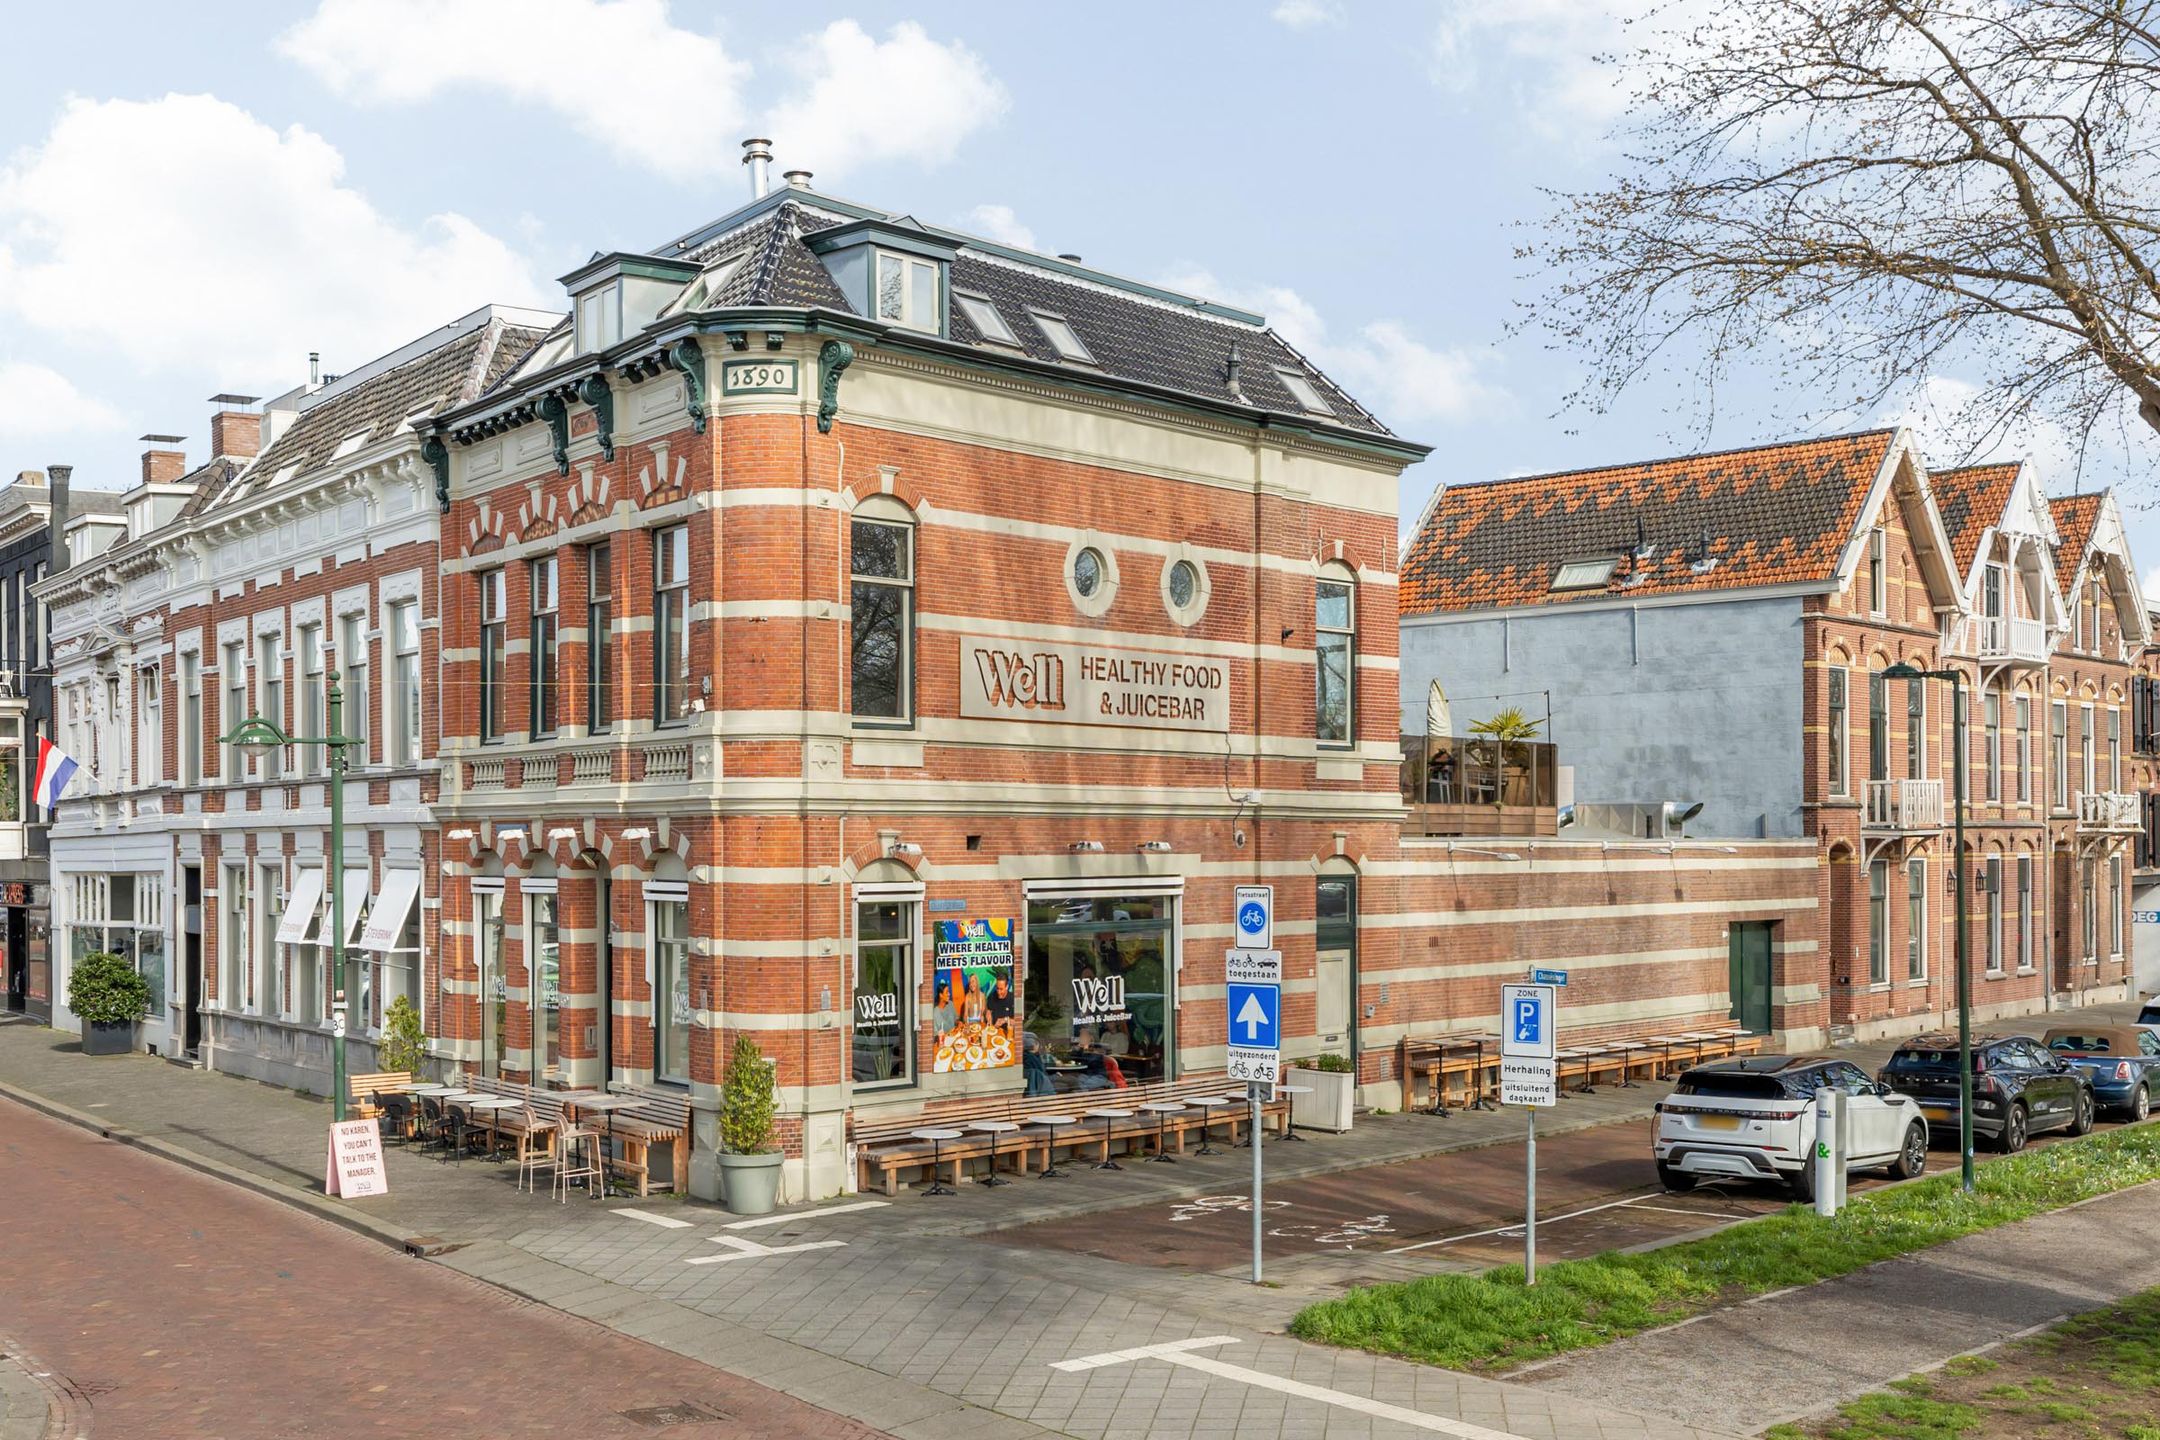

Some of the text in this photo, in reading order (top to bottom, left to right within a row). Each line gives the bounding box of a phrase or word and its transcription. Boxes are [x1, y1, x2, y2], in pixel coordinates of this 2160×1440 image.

[733, 366, 785, 386] 1890
[1081, 656, 1222, 689] HEALTHY FOOD
[974, 648, 1066, 711] Well
[1100, 692, 1205, 720] & JUICEBAR
[965, 923, 985, 938] Well
[938, 941, 1010, 954] WHERE HEALTH
[937, 955, 1012, 968] MEETS FLAVOUR
[1229, 970, 1277, 979] toegestaan
[1072, 975, 1126, 1013] Well
[1517, 989, 1538, 997] ZONE
[857, 993, 896, 1019] Well
[1520, 1002, 1535, 1024] P
[1073, 1015, 1095, 1025] Health
[1228, 1050, 1276, 1060] uitgezonderd
[1504, 1064, 1551, 1077] Herhaling
[1505, 1083, 1550, 1093] uitsluitend
[1509, 1094, 1546, 1103] dagkaart
[341, 1127, 349, 1136] NO
[344, 1139, 372, 1150] YOU CAN'T
[342, 1152, 377, 1164] TALK TO THE
